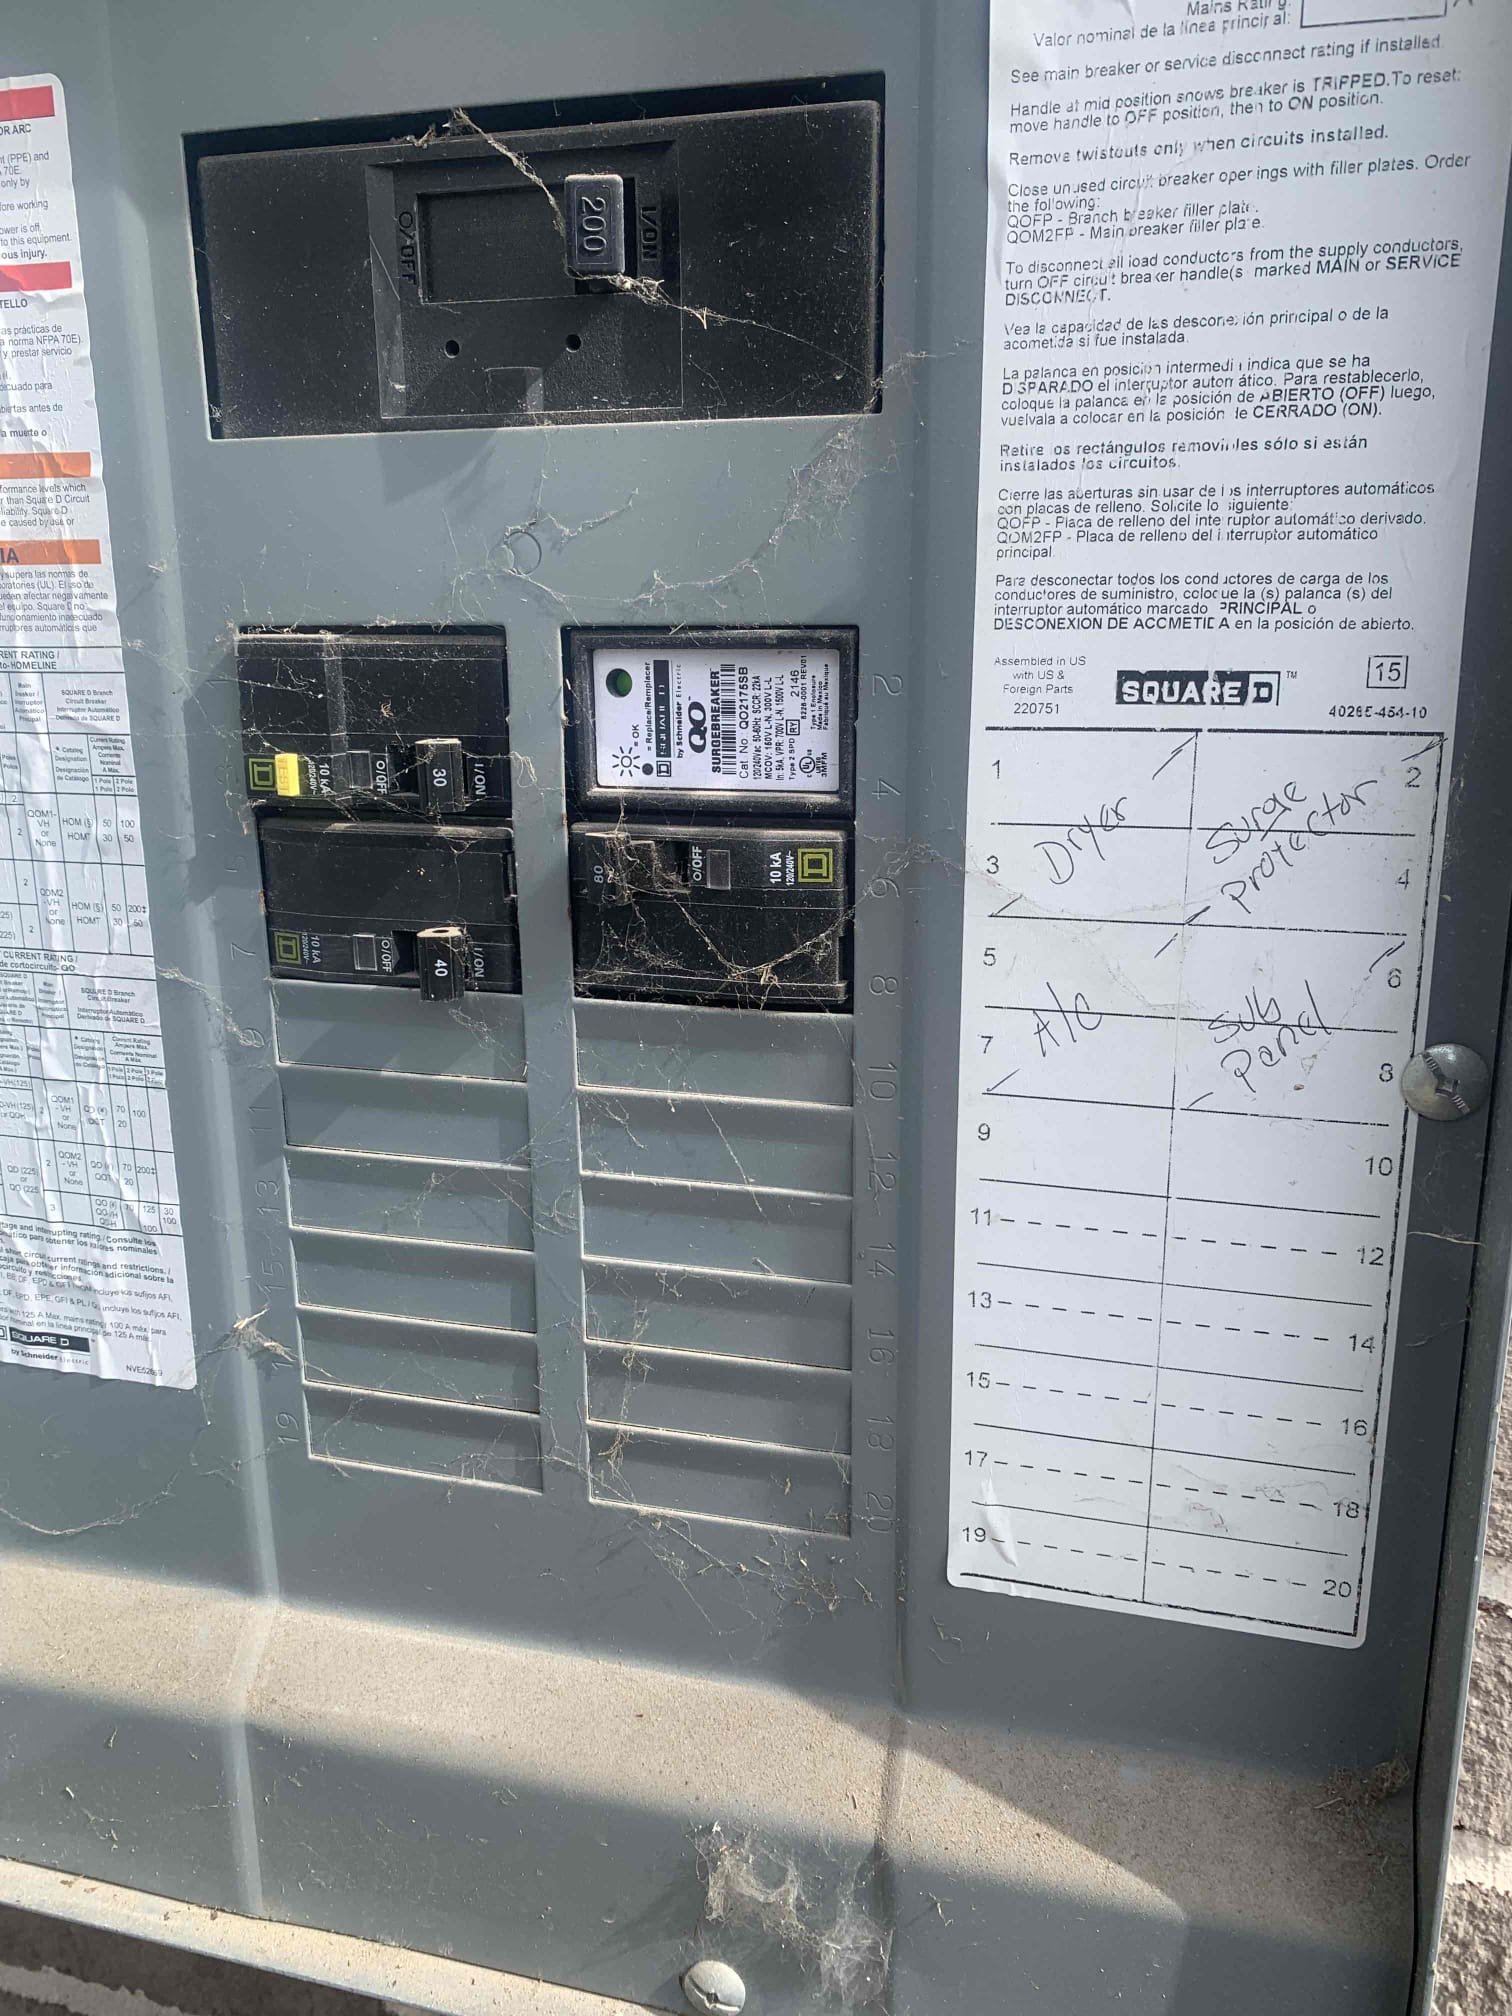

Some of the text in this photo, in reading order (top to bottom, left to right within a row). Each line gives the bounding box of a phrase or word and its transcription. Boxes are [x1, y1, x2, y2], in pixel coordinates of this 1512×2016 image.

[1011, 39, 1370, 83] See main breaker or service rating if
[1011, 68, 1461, 116] Handle mid is reset:
[1010, 92, 1383, 133] move handle to ON position.
[12, 124, 31, 135] ARC
[1242, 125, 1387, 147] circuits installed.
[7, 152, 49, 164] (PPE) and
[1009, 154, 1470, 197] Close with filler plates. Order
[18, 200, 48, 211] working
[582, 197, 607, 253] 200
[1006, 238, 1463, 274] To from the supply conductors,
[1005, 254, 1461, 290] turn marked MAIN or SERVICE
[36, 335, 60, 345] NFPA
[1248, 357, 1346, 371] indica que se
[1284, 369, 1424, 385] Para restablecerlo,
[28, 404, 49, 412] antes
[1253, 403, 1382, 418] CERRADO (ON).
[64, 484, 86, 492] which
[1247, 482, 1434, 499] interruptores automáticos
[65, 495, 90, 503] Circuit
[1297, 527, 1378, 540] automático
[1031, 575, 1113, 586] desconectar
[995, 603, 1208, 616] interruptor marcado
[1274, 617, 1414, 632] posición abierto.
[11, 661, 56, 670] HOMELINE
[995, 657, 1086, 665] Assembled in US
[1013, 670, 1053, 680] with US
[1376, 662, 1400, 681] 15
[752, 676, 760, 690] 22kA
[791, 670, 799, 697] 2146
[873, 677, 902, 696] 2
[1003, 685, 1073, 694] Foreign Parts
[1120, 679, 1243, 704] SQUARE
[645, 663, 653, 743] Replace/Remplacer
[739, 667, 748, 729] QO2175SB
[764, 692, 772, 711] 300V
[775, 688, 783, 705] 1500V
[1014, 703, 1059, 714] 220751
[688, 702, 706, 753] QO
[710, 671, 721, 773] SURGEBREAKER
[753, 718, 761, 742] 50-60Hz
[790, 722, 797, 733] RY
[632, 725, 639, 738] OK
[677, 749, 684, 758] by
[320, 763, 328, 778] 10
[377, 761, 387, 794] O/OFF
[433, 768, 446, 787] 30
[993, 761, 1000, 778] 1
[475, 764, 486, 795] I/ON
[1406, 769, 1421, 788] 2
[872, 780, 900, 799] 4
[102, 820, 135, 828] 50 100
[1207, 781, 1307, 864] Surge
[1035, 796, 1127, 885] Dryer
[693, 847, 702, 881] O/OFF
[770, 853, 782, 884] 10 kA
[987, 857, 999, 874] 3
[1398, 873, 1410, 888] 4
[311, 936, 320, 963] 10 kA
[382, 939, 392, 972] O/OFF
[984, 949, 996, 966] 5
[435, 959, 447, 976] 40
[475, 948, 484, 978] I/ON
[869, 976, 898, 995] 8
[1387, 970, 1401, 989] 6
[1033, 982, 1102, 1056] A/C
[981, 1037, 993, 1053] 7
[1221, 980, 1332, 1093] Panel
[1380, 1064, 1393, 1082] 8
[867, 1063, 898, 1101] 10
[978, 1124, 990, 1142] 9
[1365, 1157, 1392, 1175] 10
[970, 1209, 991, 1225] 11
[868, 1242, 896, 1279] 14
[1357, 1247, 1383, 1265] 12
[968, 1293, 991, 1308] 13
[868, 1329, 896, 1365] 16
[1349, 1336, 1374, 1353] 14
[967, 1373, 989, 1388] 15
[1341, 1419, 1367, 1436] 16
[965, 1451, 988, 1466] 17
[1333, 1502, 1360, 1519] 18
[962, 1528, 986, 1543] 19
[1323, 1580, 1351, 1597] 20
